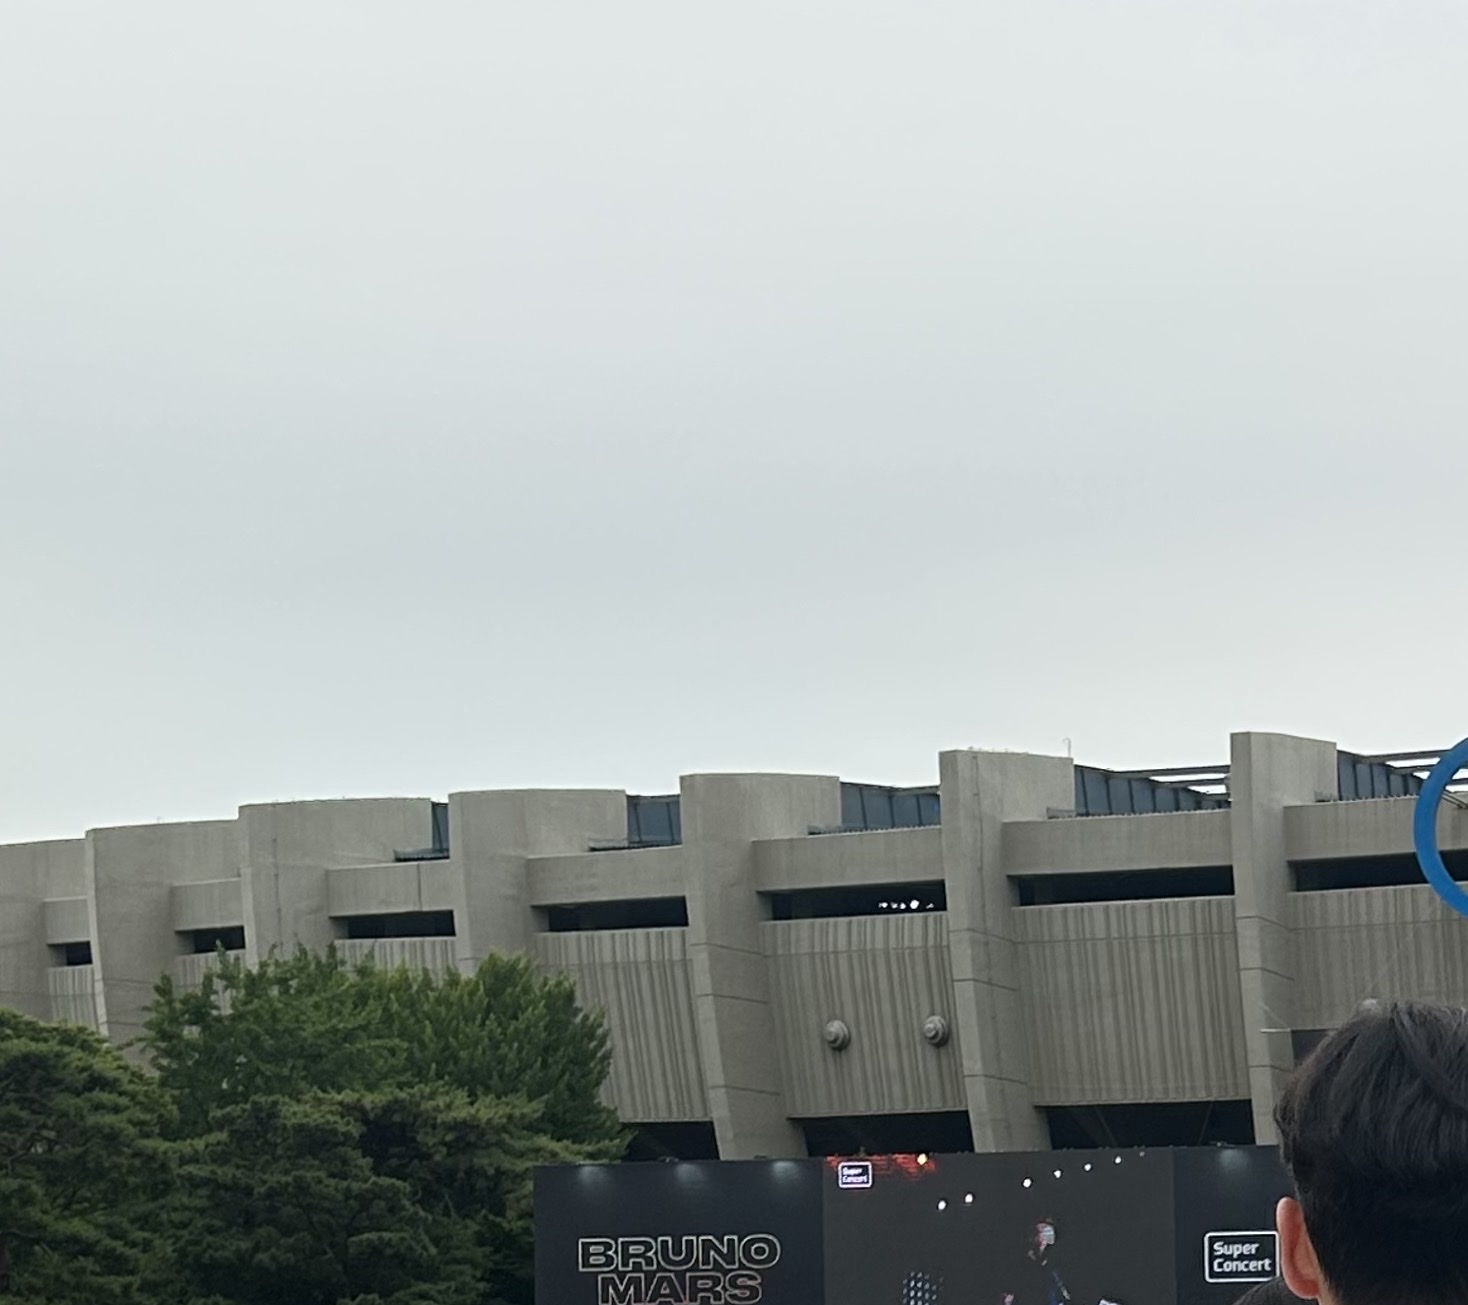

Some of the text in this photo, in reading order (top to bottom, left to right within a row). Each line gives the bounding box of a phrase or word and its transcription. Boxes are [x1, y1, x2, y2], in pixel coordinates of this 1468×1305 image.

[578, 1233, 781, 1272] BRUNO
[1213, 1241, 1260, 1258] Super
[1213, 1258, 1272, 1272] Concert
